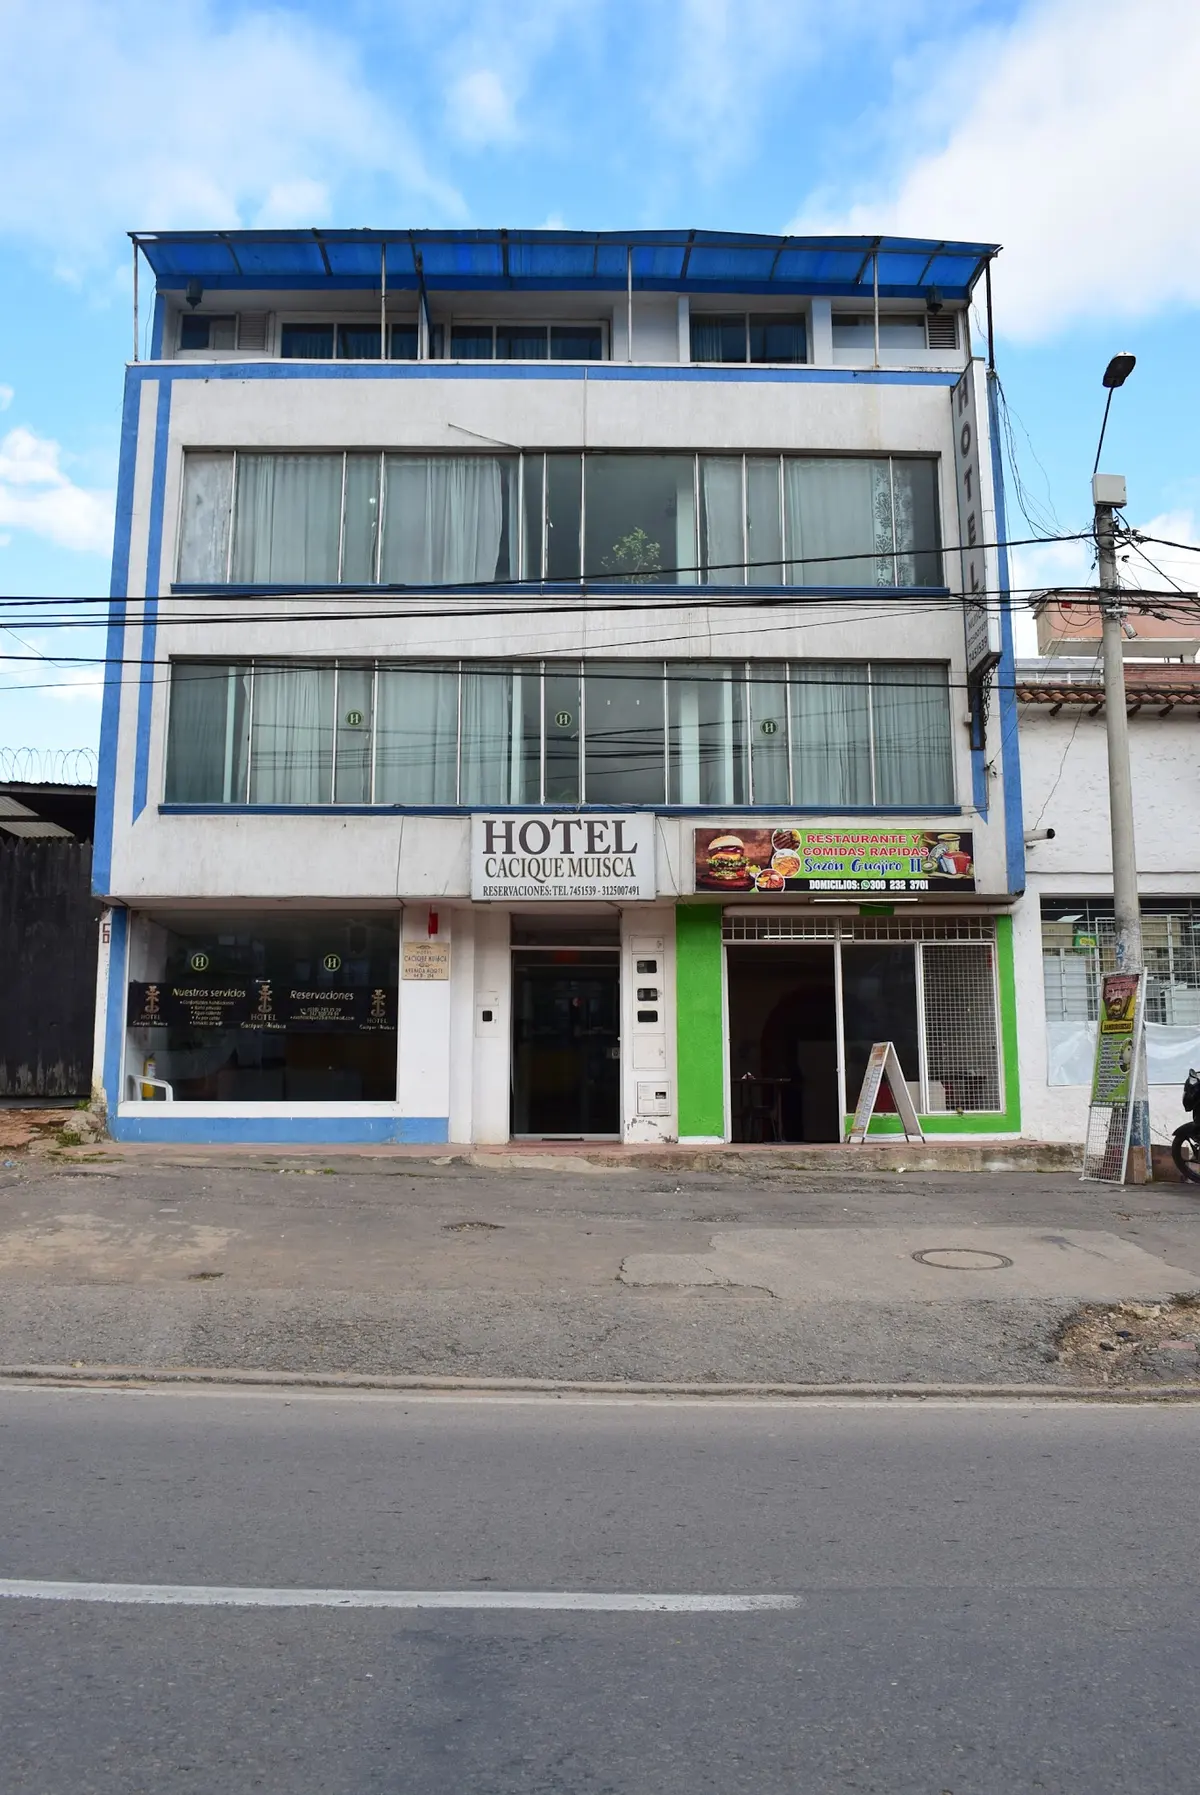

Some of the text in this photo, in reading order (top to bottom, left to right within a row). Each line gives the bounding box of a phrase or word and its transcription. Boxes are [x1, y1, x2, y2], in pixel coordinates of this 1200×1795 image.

[957, 368, 979, 592] HOTEL
[482, 818, 638, 855] HOTEL
[806, 834, 920, 844] RESTAURANTE Y
[803, 845, 929, 857] COMIDAS RÁPIDAS
[485, 856, 636, 884] CACIQUE MUISCA
[804, 858, 922, 876] Sazón Guajiro II
[809, 879, 929, 890] DOMICILIOS: 300 232 3701
[569, 885, 597, 896] 7451539
[601, 885, 640, 896] 3125007491
[172, 988, 246, 998] Nuestros servicios
[290, 990, 355, 1001] Reservaciones
[250, 1013, 277, 1021] HOTEL
